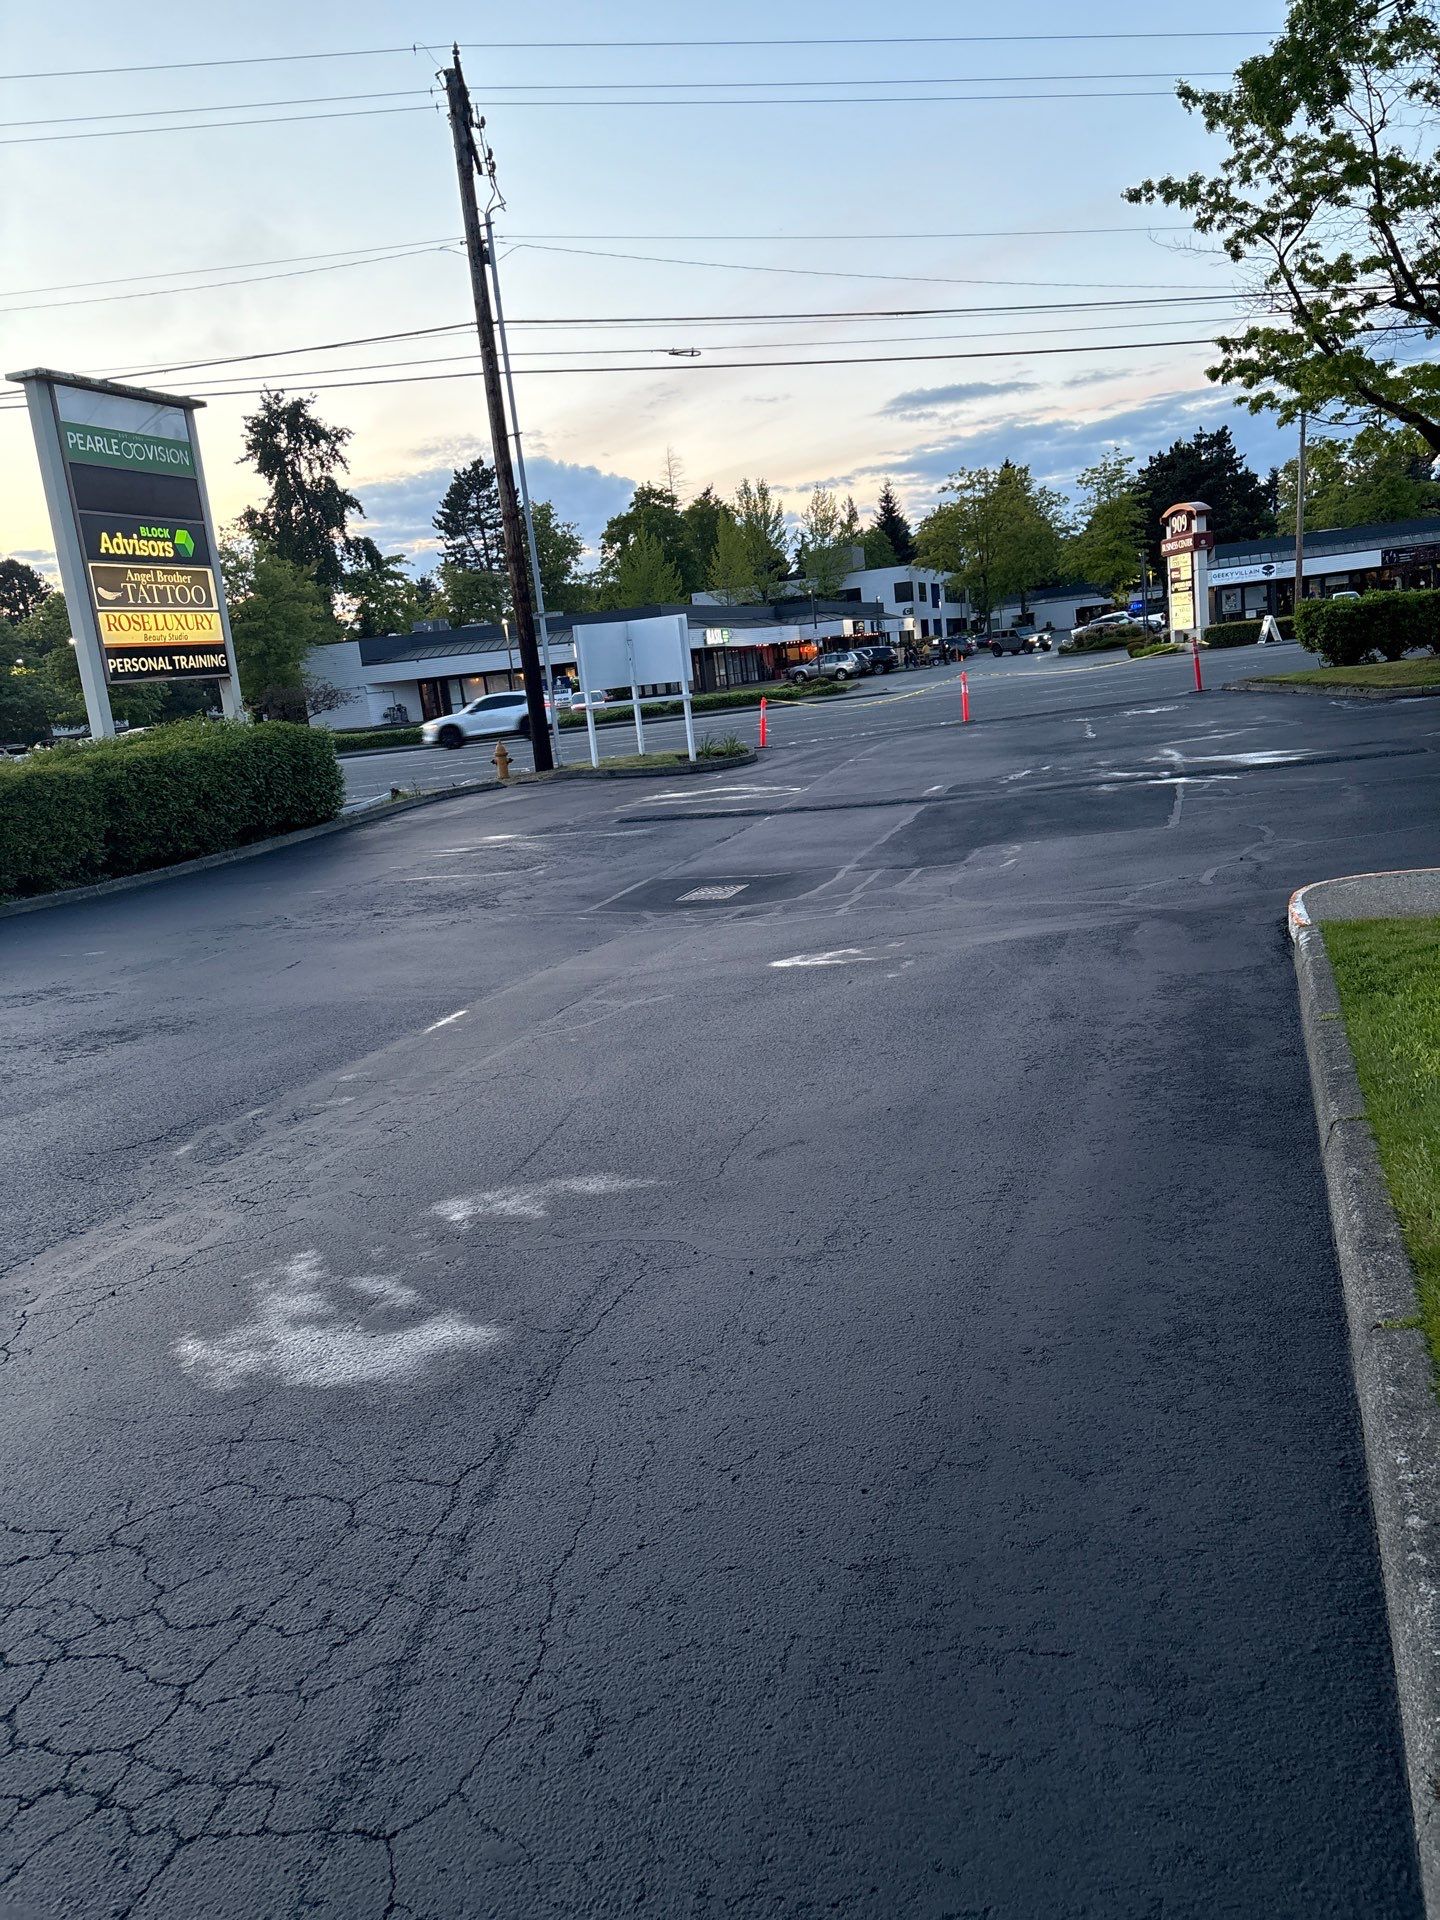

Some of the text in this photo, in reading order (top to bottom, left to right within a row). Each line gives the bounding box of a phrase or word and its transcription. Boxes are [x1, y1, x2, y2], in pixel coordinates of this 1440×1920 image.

[66, 431, 120, 456] PEARLE
[143, 443, 190, 466] VISION
[140, 526, 170, 539] BLOCK
[1171, 514, 1187, 534] 909
[100, 532, 174, 557] Advisors
[1161, 538, 1193, 552] BUSINESS CENTER
[126, 569, 192, 585] Angel Brother
[121, 583, 207, 605] TATTOO
[105, 613, 214, 632] ROSE LUXURY
[143, 633, 189, 642] Beauty Studio
[107, 653, 227, 673] PERSONAL TRAINING
